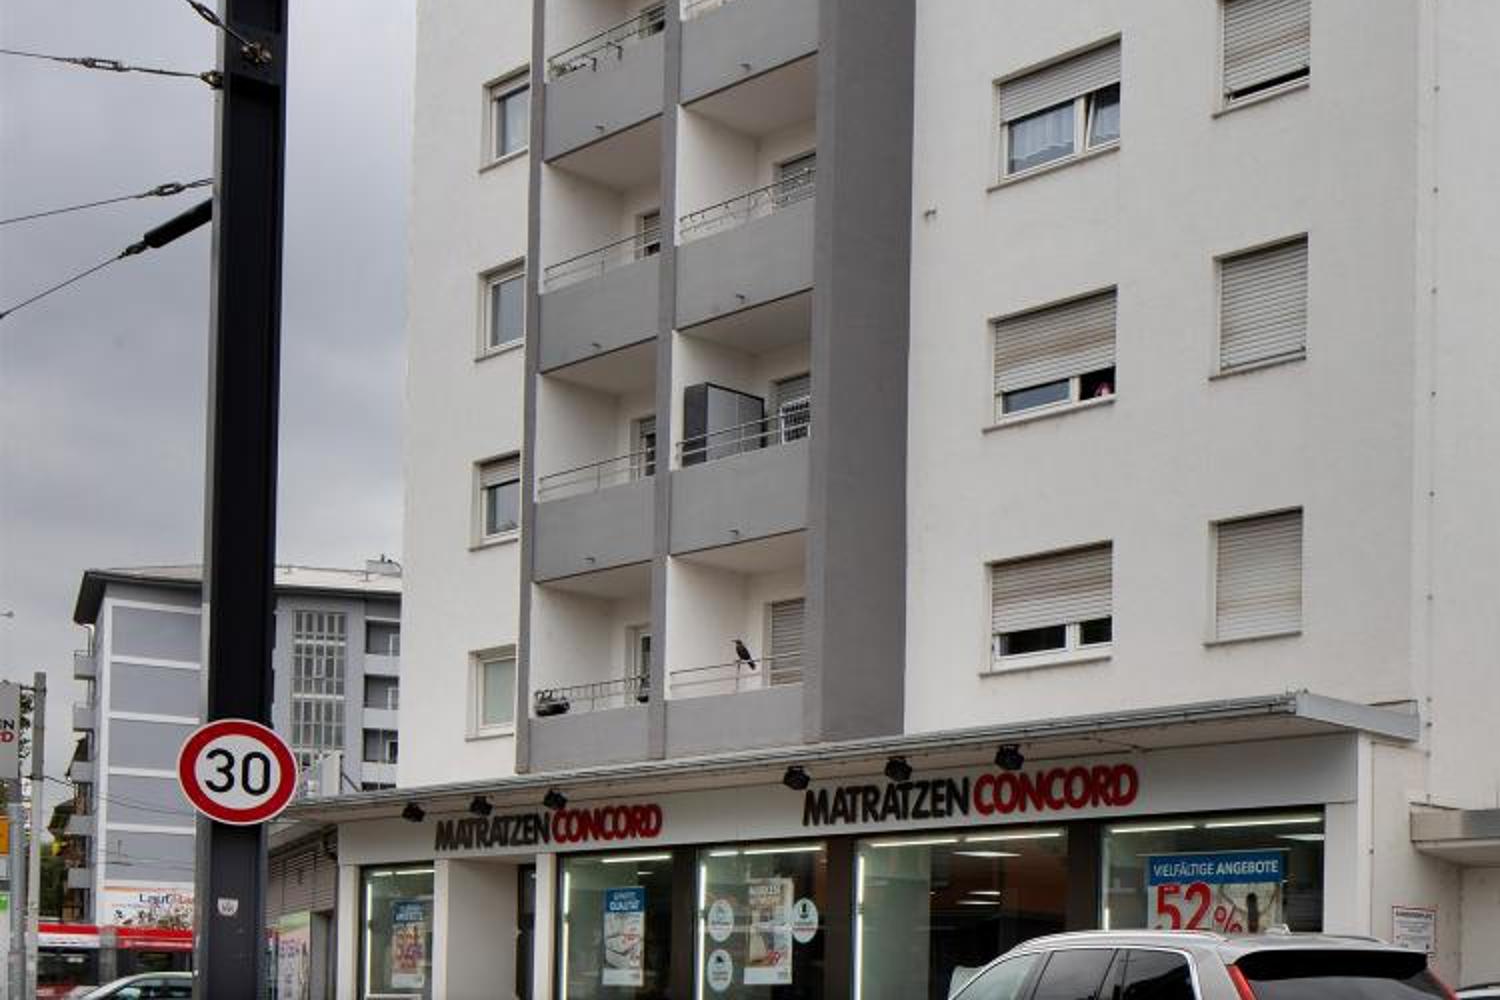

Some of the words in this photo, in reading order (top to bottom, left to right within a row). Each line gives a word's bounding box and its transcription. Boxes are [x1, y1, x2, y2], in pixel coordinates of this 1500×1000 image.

[205, 748, 271, 796] 30
[802, 776, 969, 827] MATRATZEN
[973, 764, 1138, 816] CONCORD
[434, 812, 549, 851] MATRATZEN
[551, 803, 664, 845] CONCORD
[1153, 863, 1214, 877] VIELFÄLTIGE
[1215, 860, 1279, 874] ANGEBOTE
